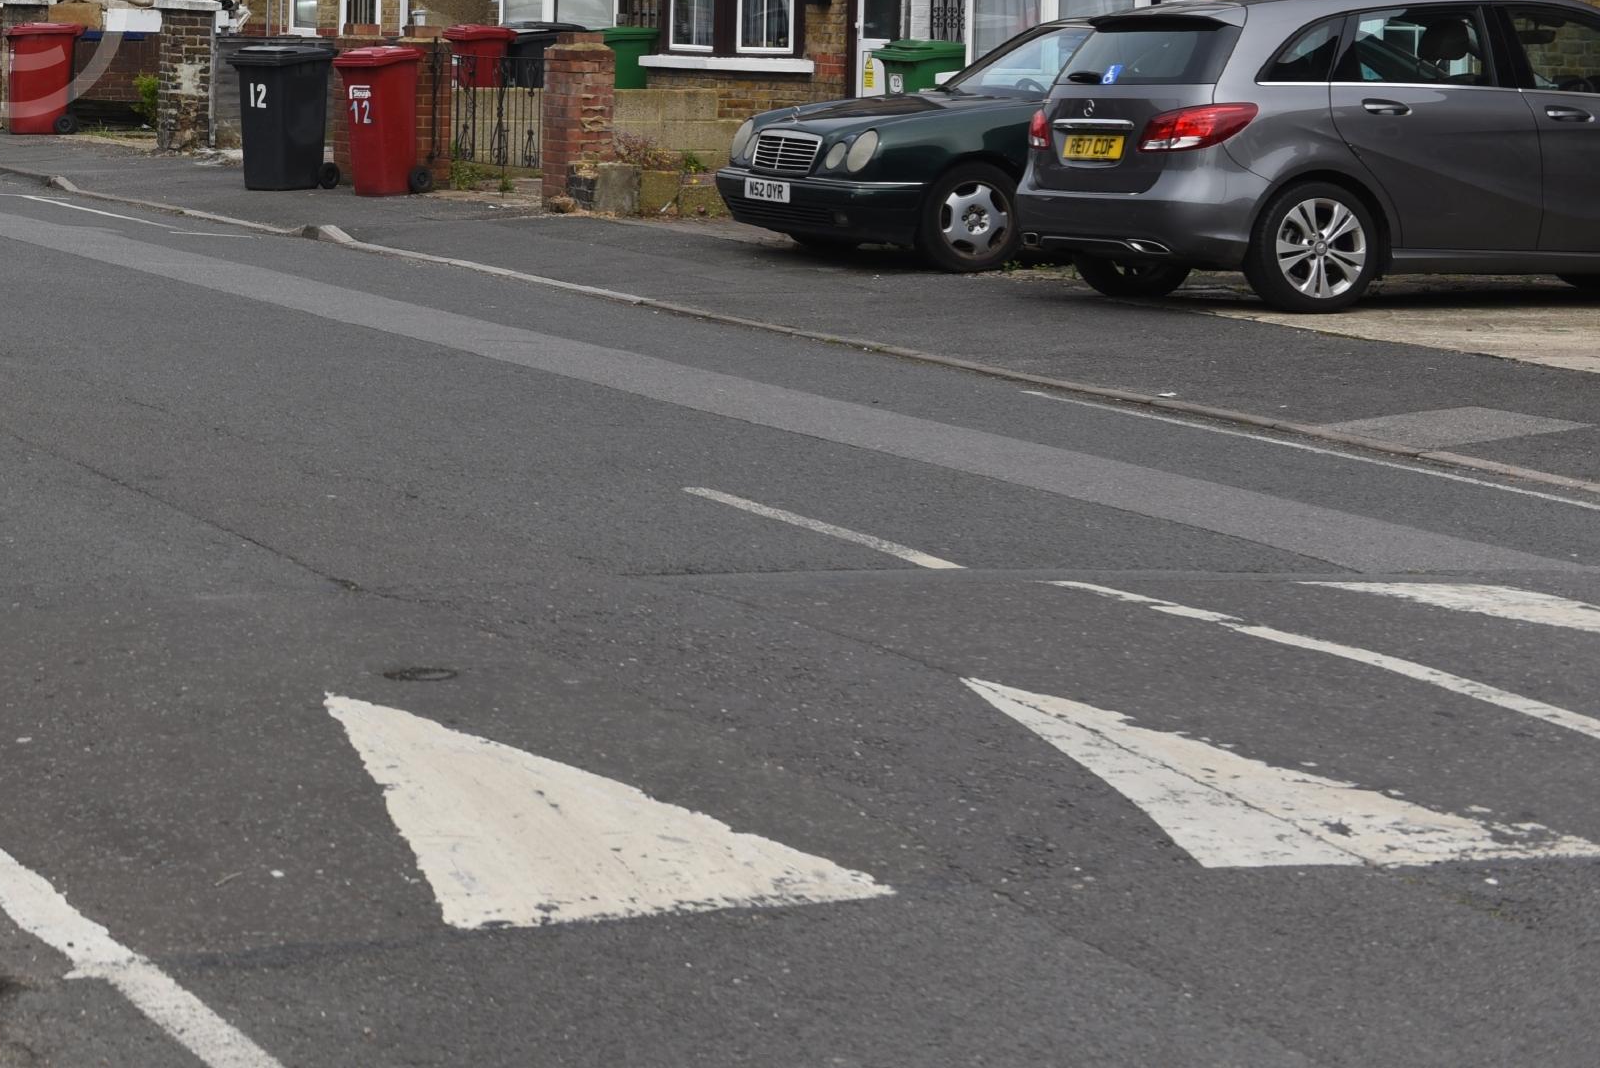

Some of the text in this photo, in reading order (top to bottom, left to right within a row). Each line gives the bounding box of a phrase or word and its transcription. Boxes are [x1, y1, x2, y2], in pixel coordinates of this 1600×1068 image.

[249, 82, 267, 109] 12
[351, 100, 372, 124] 12
[1093, 137, 1117, 155] CDF
[750, 181, 784, 200] N52 OYR
